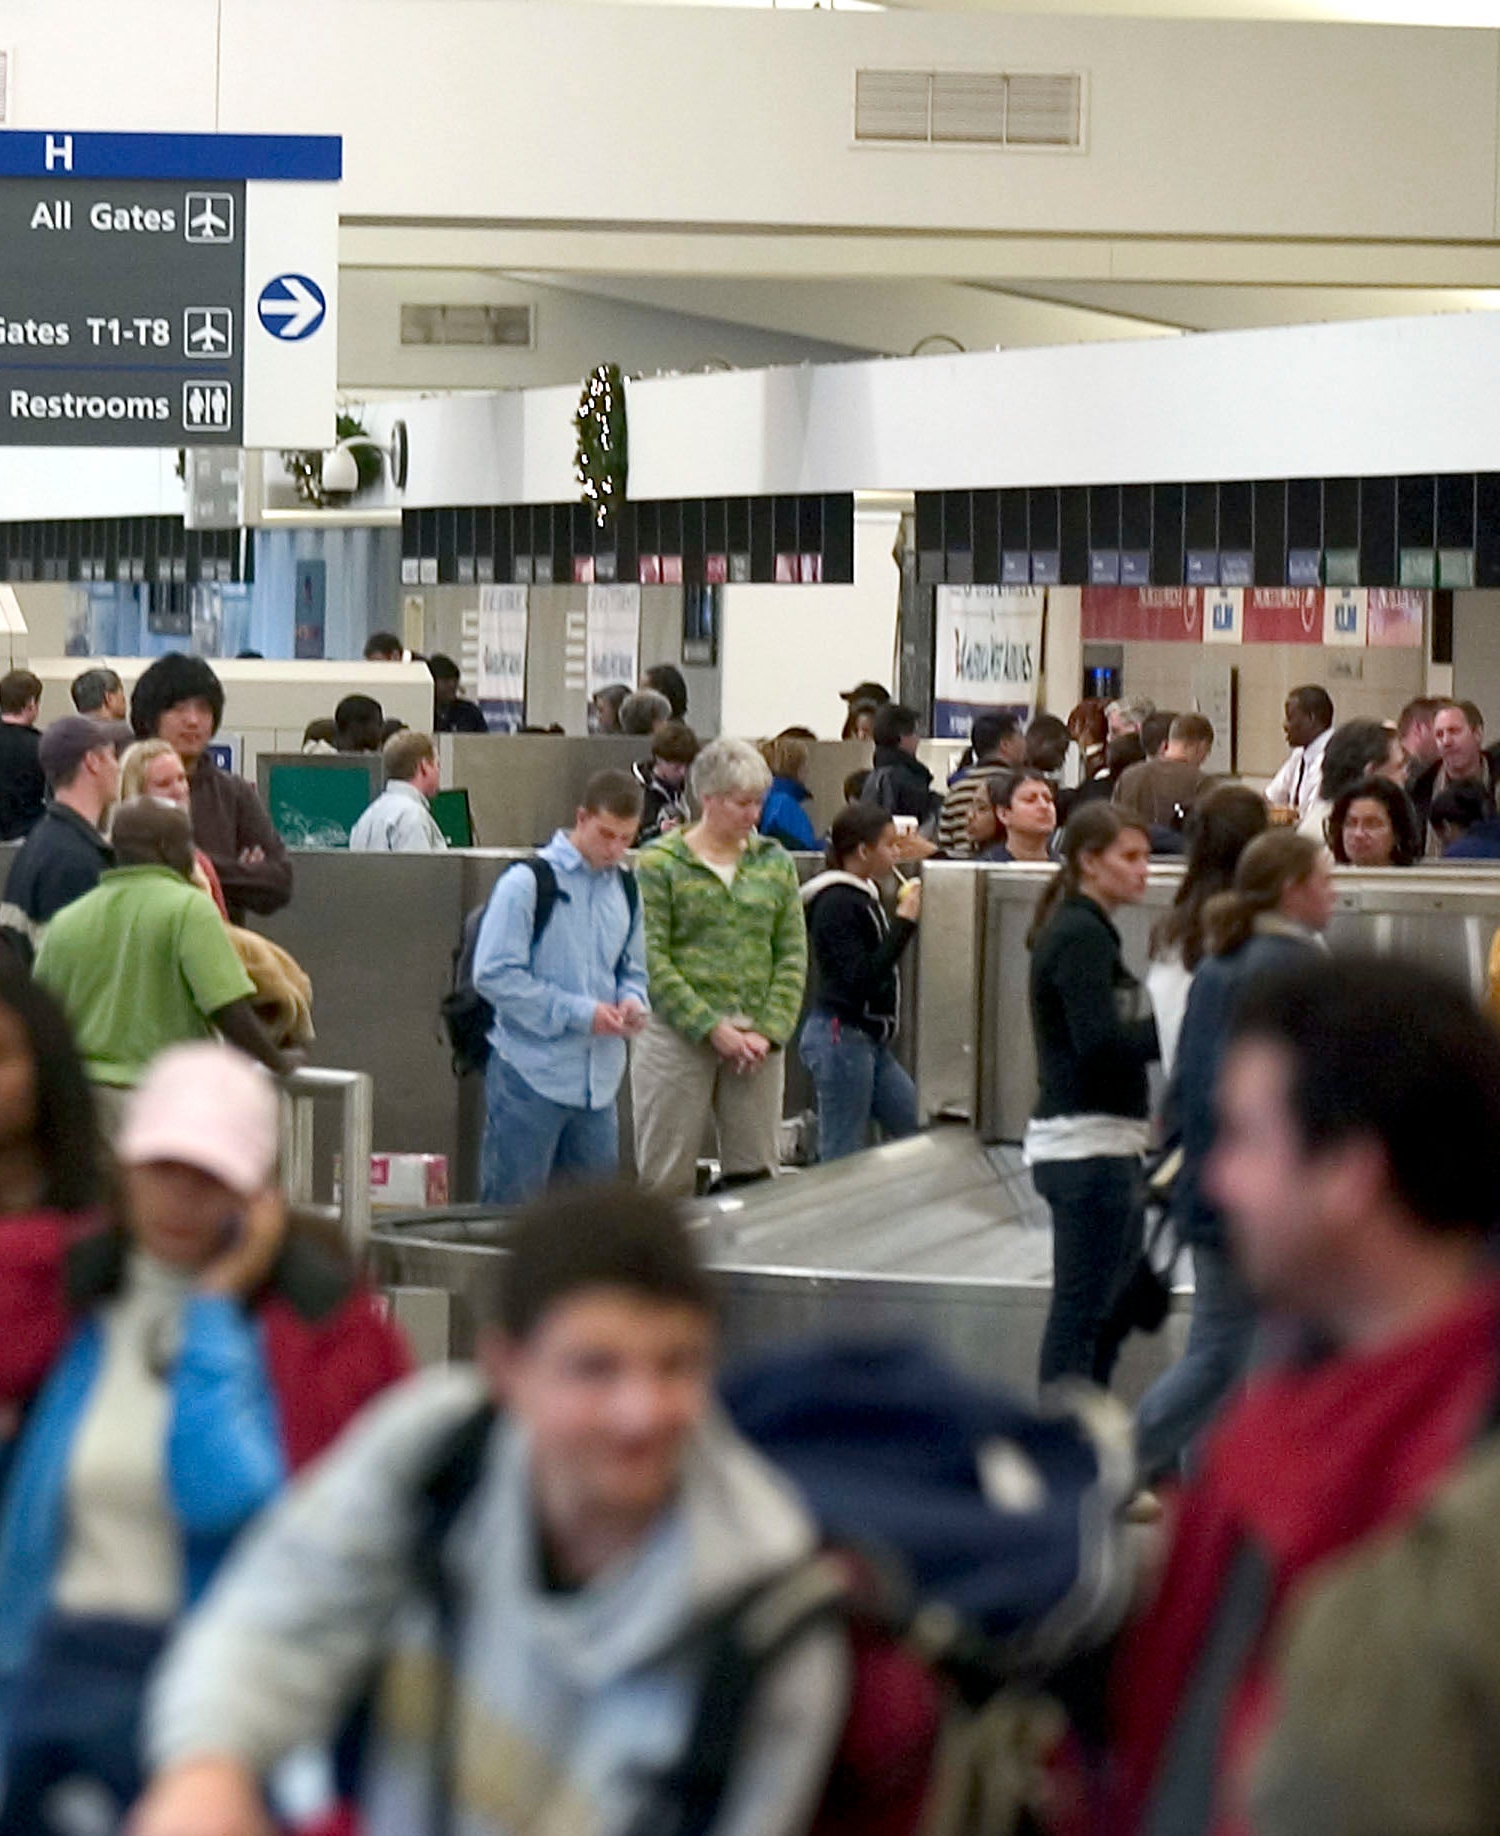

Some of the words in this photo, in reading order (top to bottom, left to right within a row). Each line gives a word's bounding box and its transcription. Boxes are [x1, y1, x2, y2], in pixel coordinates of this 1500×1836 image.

[30, 200, 71, 230] All
[90, 202, 176, 232] Gates
[86, 317, 171, 346] T1-T8
[10, 390, 170, 420] Restrooms
